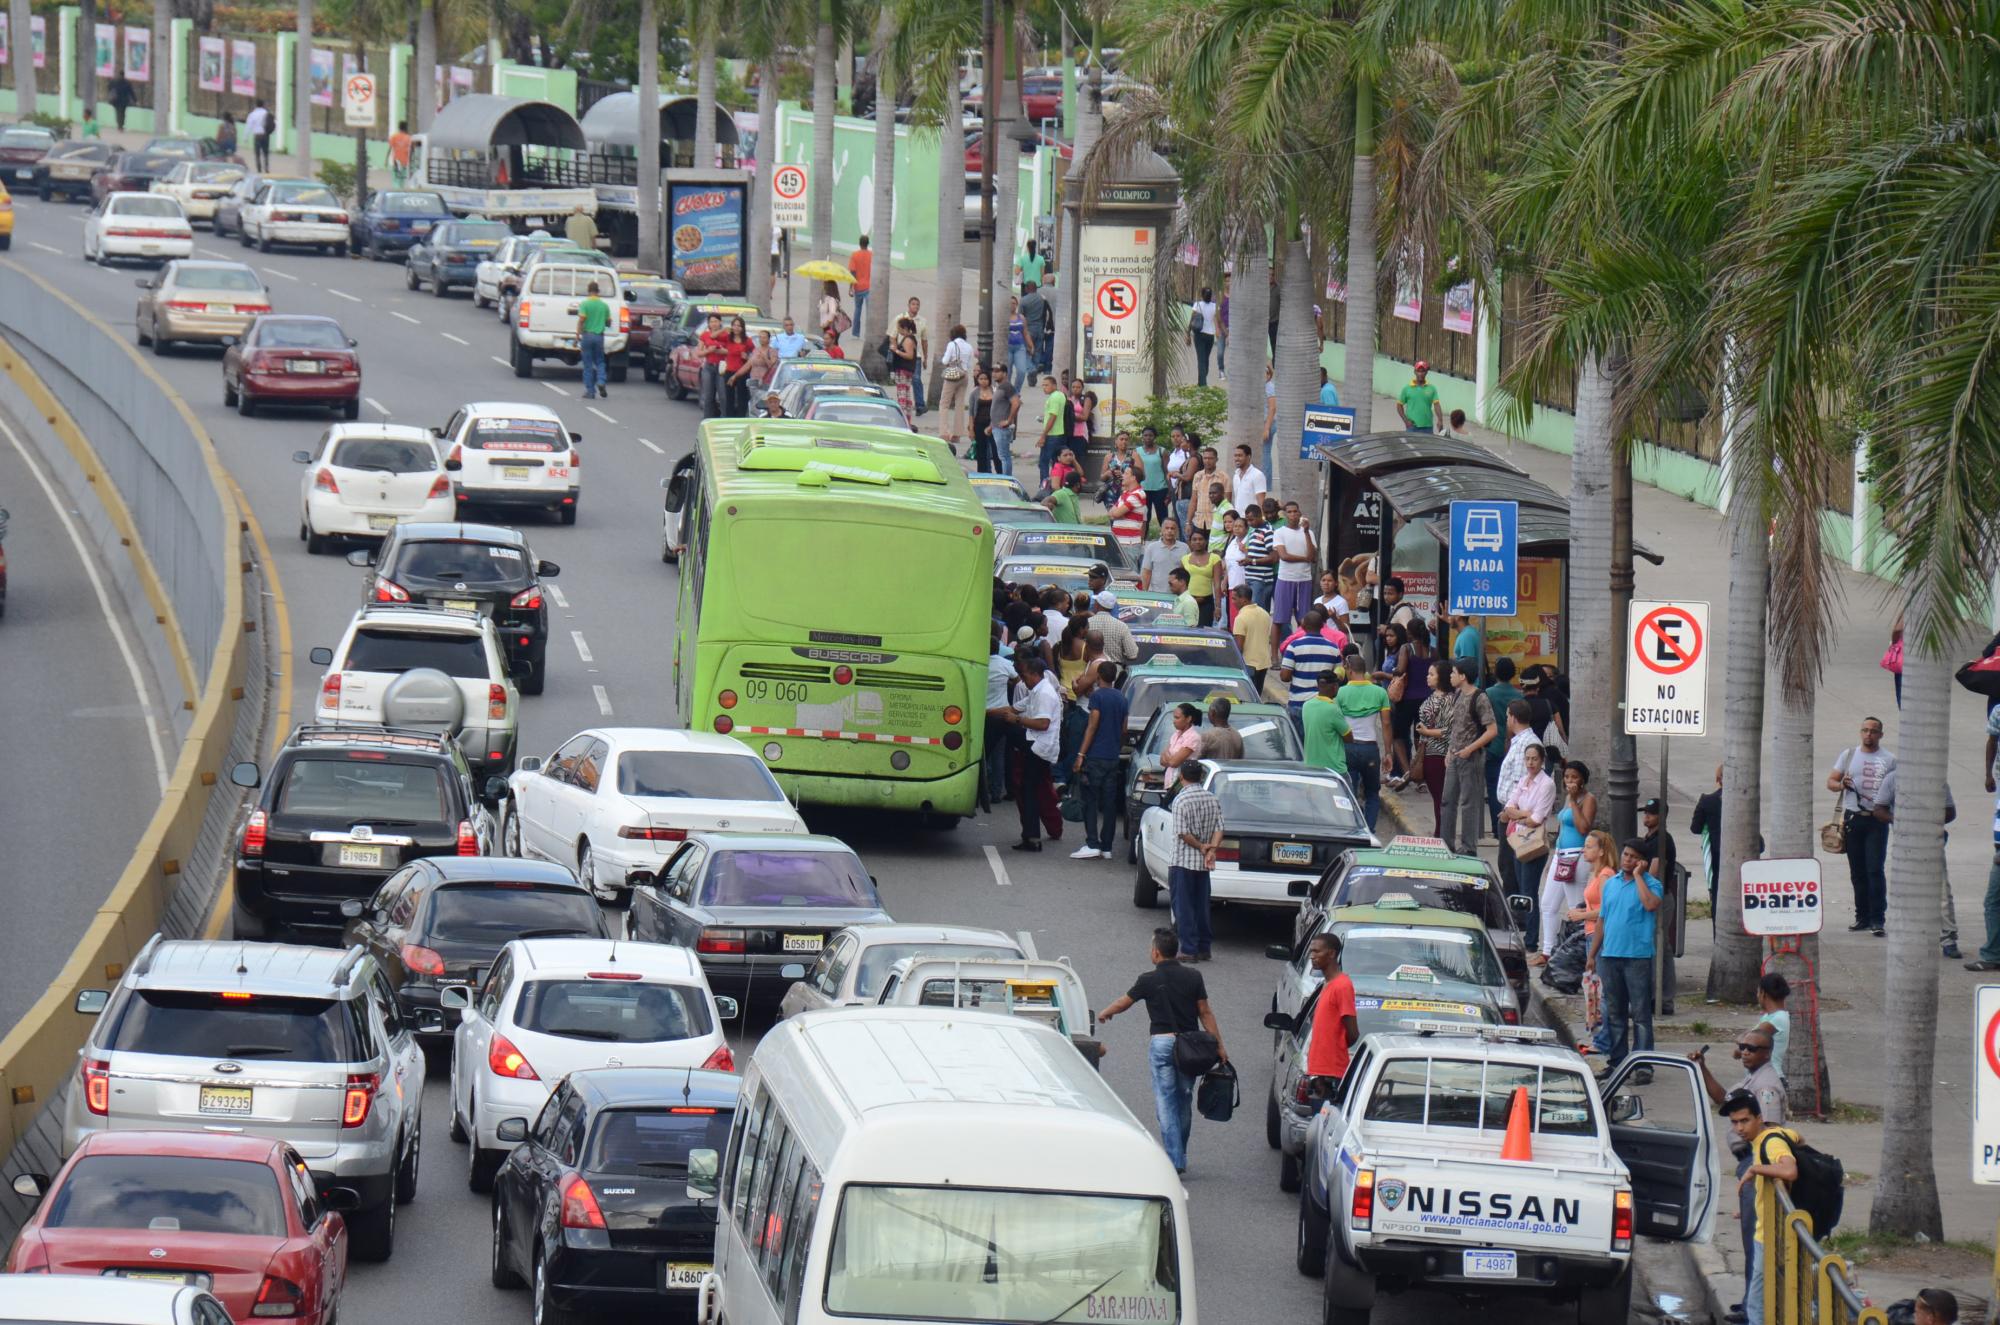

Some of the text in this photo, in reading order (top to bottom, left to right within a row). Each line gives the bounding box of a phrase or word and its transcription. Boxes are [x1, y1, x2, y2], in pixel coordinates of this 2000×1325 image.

[781, 174, 798, 186] 45
[1113, 190, 1151, 200] OLIMPICO
[1110, 287, 1124, 311] E
[1110, 325, 1122, 335] NO
[1096, 339, 1136, 349] ESTACIONE
[1459, 559, 1504, 572] PARADA
[1472, 579, 1490, 591] 36
[1457, 595, 1508, 609] AUTOBUS
[1657, 620, 1682, 660] E
[808, 649, 882, 663] BUSSCAR
[746, 680, 807, 702] 09 060
[1657, 685, 1675, 699] NO
[1632, 708, 1700, 724] ESTACIONE
[1756, 881, 1818, 893] nuevo
[1744, 894, 1818, 909] Diario
[785, 940, 820, 949] A058107
[1407, 1186, 1580, 1225] NISSAN
[1382, 1222, 1421, 1232] NP300
[1420, 1213, 1568, 1234] www.policianacional.gob.do
[1476, 1258, 1513, 1271] F-4987
[1087, 1294, 1168, 1320] BARAHONA
